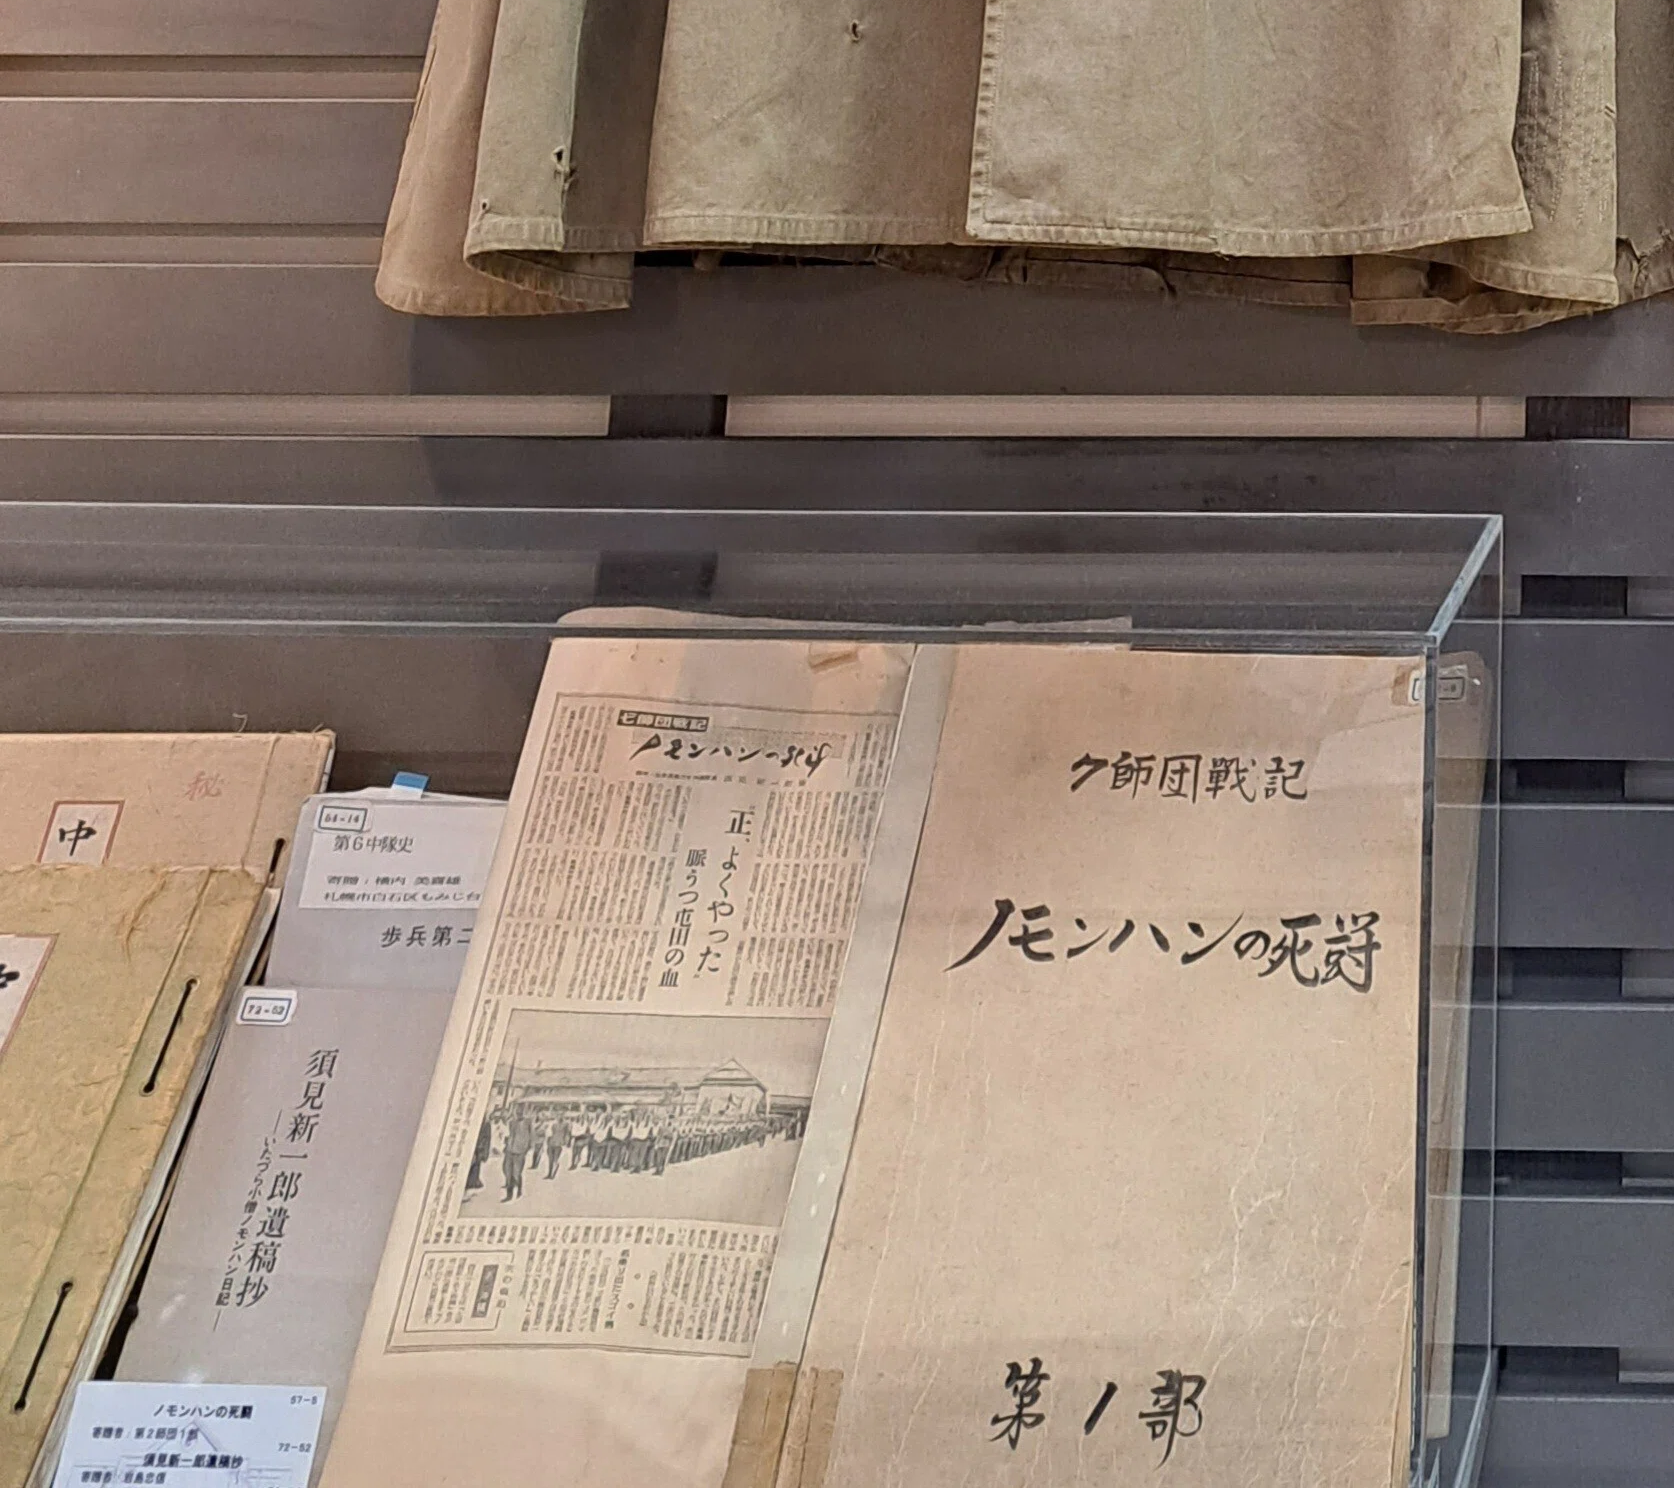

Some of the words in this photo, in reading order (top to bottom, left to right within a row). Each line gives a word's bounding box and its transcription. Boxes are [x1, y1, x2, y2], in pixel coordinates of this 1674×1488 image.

[58, 818, 97, 857] 中
[333, 834, 414, 854] 第6中隊史
[236, 1048, 340, 1308] 須見新一郎遺稿抄
[988, 1356, 1207, 1472] 第1部
